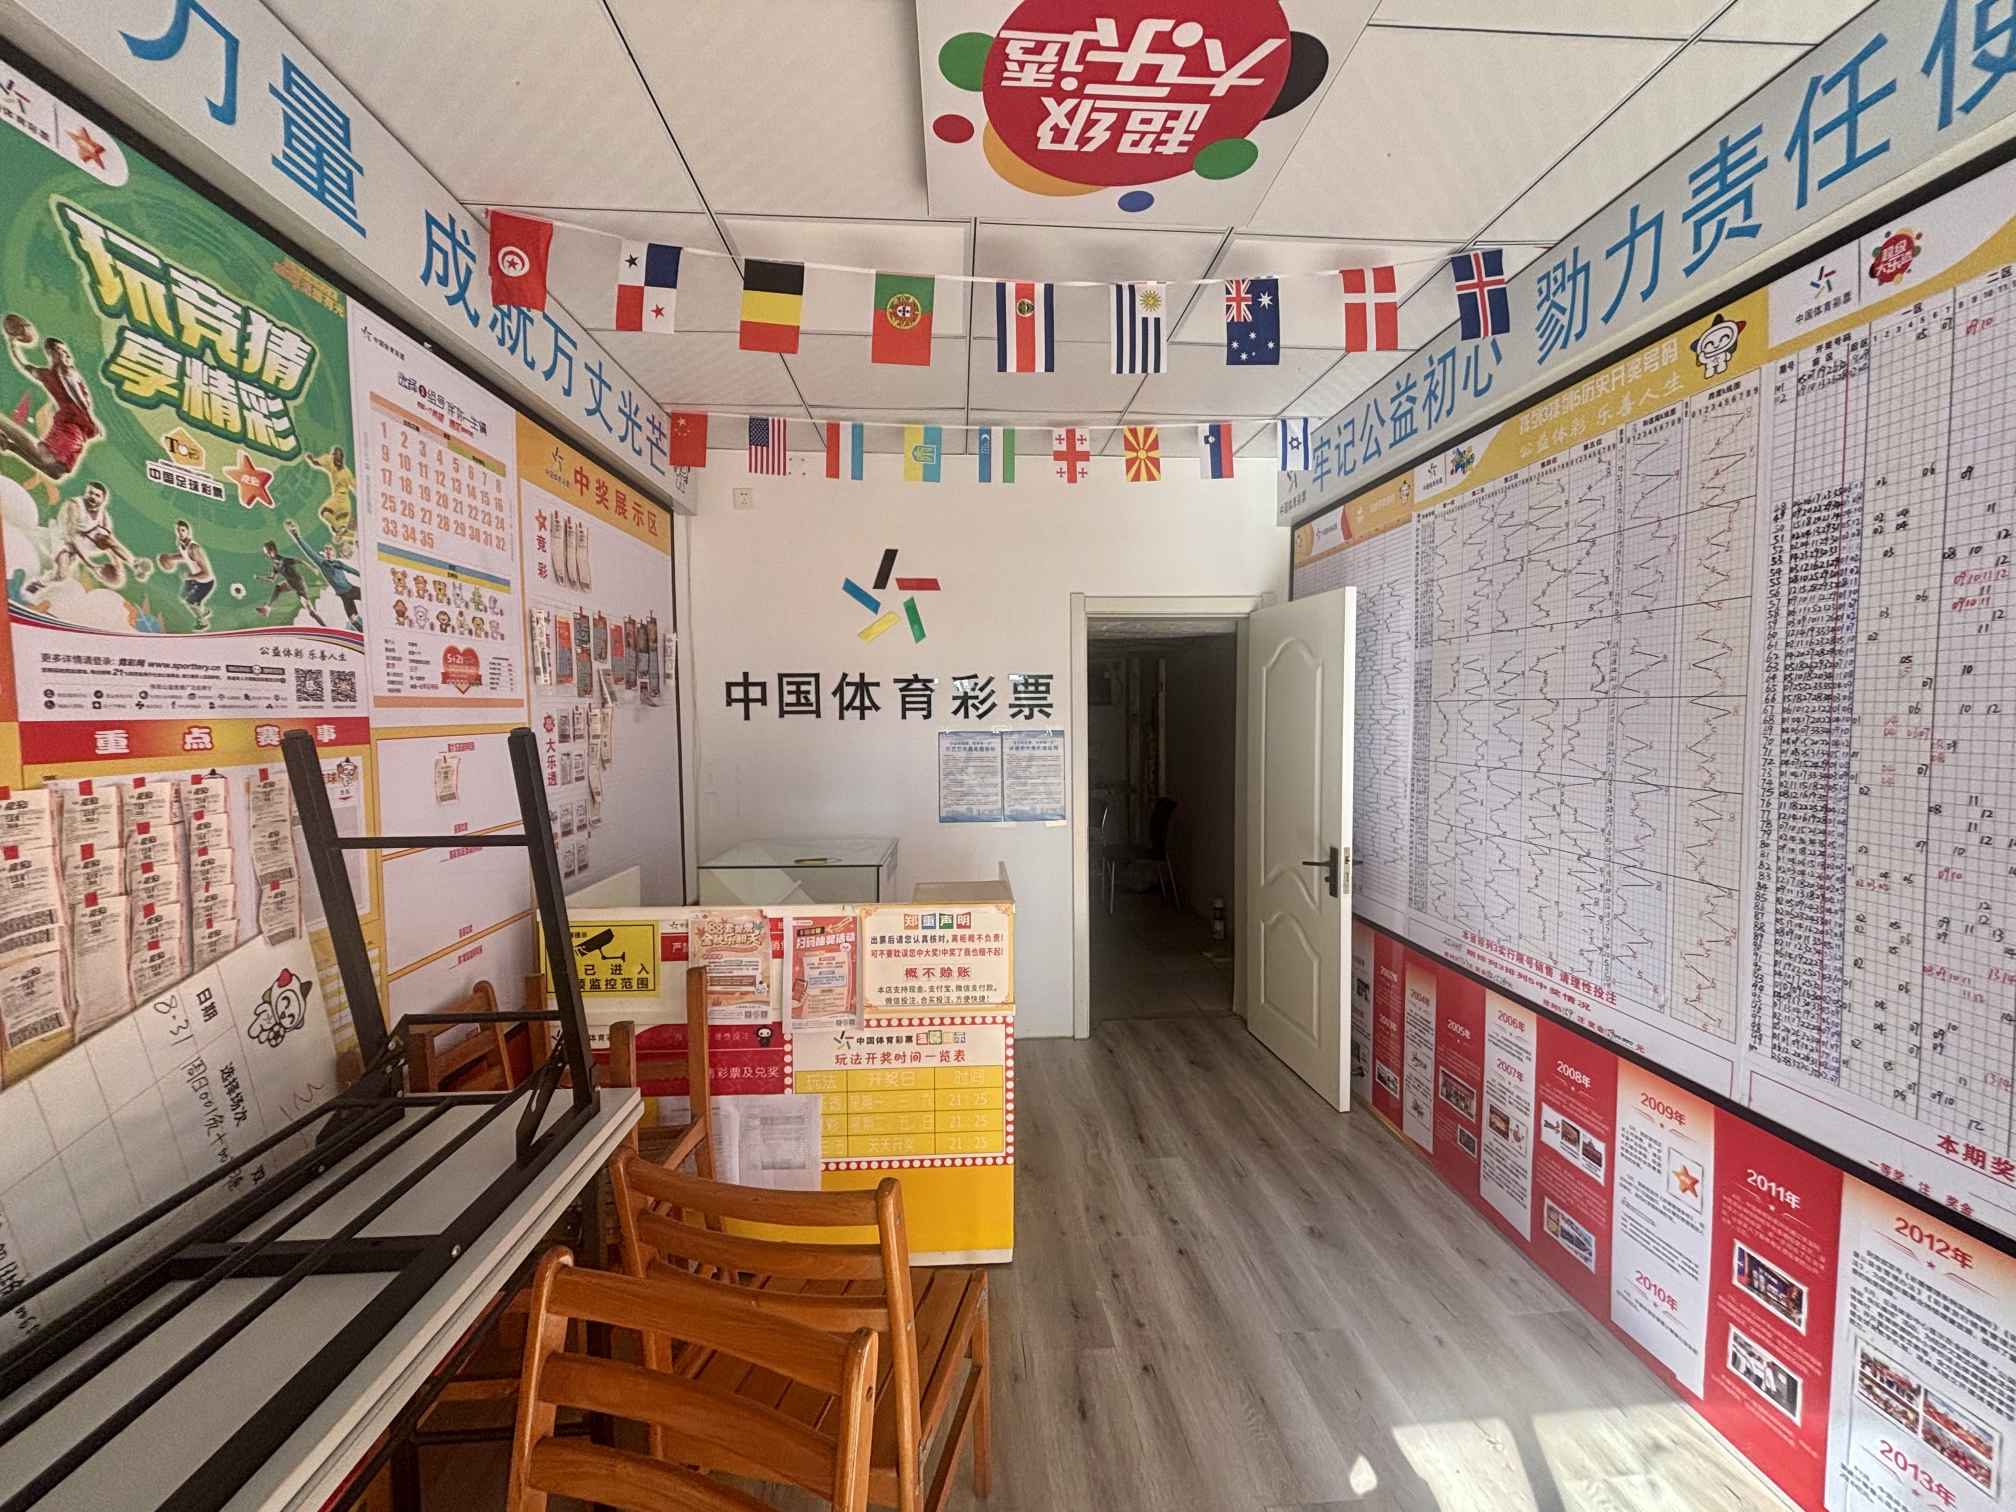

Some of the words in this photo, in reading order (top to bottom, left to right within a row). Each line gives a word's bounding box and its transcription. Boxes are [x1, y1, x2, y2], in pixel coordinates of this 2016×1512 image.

[1001, 18, 1287, 97] 大乐透
[1037, 97, 1211, 155] 超级
[1987, 266, 2012, 284] 二区
[62, 206, 314, 394] 玩竞猜
[1795, 291, 1852, 323] 中国体育彩票
[109, 326, 298, 453] 享精彩
[381, 422, 387, 438] 1
[401, 431, 408, 449] 2
[419, 441, 426, 458] 3
[436, 449, 443, 465] 4
[453, 458, 459, 473] 5
[468, 465, 474, 480] 6
[482, 472, 488, 486] 7
[149, 466, 225, 499] 中国足球彩票
[399, 453, 411, 472] 10
[418, 462, 428, 479] 11
[435, 470, 446, 487] 12
[451, 478, 462, 494] 13
[467, 484, 476, 499] 14
[480, 490, 490, 506] 15
[381, 469, 392, 486] 17
[400, 476, 412, 495] 18
[419, 484, 431, 502] 19
[435, 491, 448, 509] 20
[453, 499, 464, 515] 21
[467, 505, 479, 521] 22
[481, 510, 492, 527] 23
[495, 516, 504, 531] 24
[574, 466, 659, 537] 中奖展示区
[381, 492, 396, 513] 25
[401, 500, 415, 519] 26
[420, 508, 433, 525] 27
[454, 520, 466, 537] 29
[483, 531, 492, 547] 31
[382, 517, 398, 538] 33
[402, 524, 417, 544] 34
[420, 531, 434, 550] 35
[259, 646, 304, 660] 公益体彩
[308, 646, 348, 662] 乐善人生
[724, 671, 1055, 722] 中国体育彩票
[94, 724, 337, 755] 重点赛事
[904, 911, 972, 930] 郑重声明
[576, 976, 649, 990] 频监控范围
[583, 963, 650, 976] 已进入
[904, 966, 972, 979] 概不赊账
[1560, 970, 1617, 1006] 请理性投注
[197, 987, 219, 1023] 日期
[834, 1050, 967, 1066] 玩法开奖时间一览表
[856, 1035, 914, 1045] 中国体育彩票
[1556, 1060, 1592, 1088] 2008年
[1640, 1092, 1687, 1126] 2009年
[1937, 1133, 2016, 1183] 本期奖
[1746, 1168, 1801, 1209] 2011年
[1867, 1159, 1906, 1185] 一等奖
[1946, 1194, 1974, 1216] 奖金
[1894, 1217, 1975, 1270] 2012年
[1635, 1269, 1679, 1312] 2010年
[1879, 1439, 1958, 1507] 2013年
